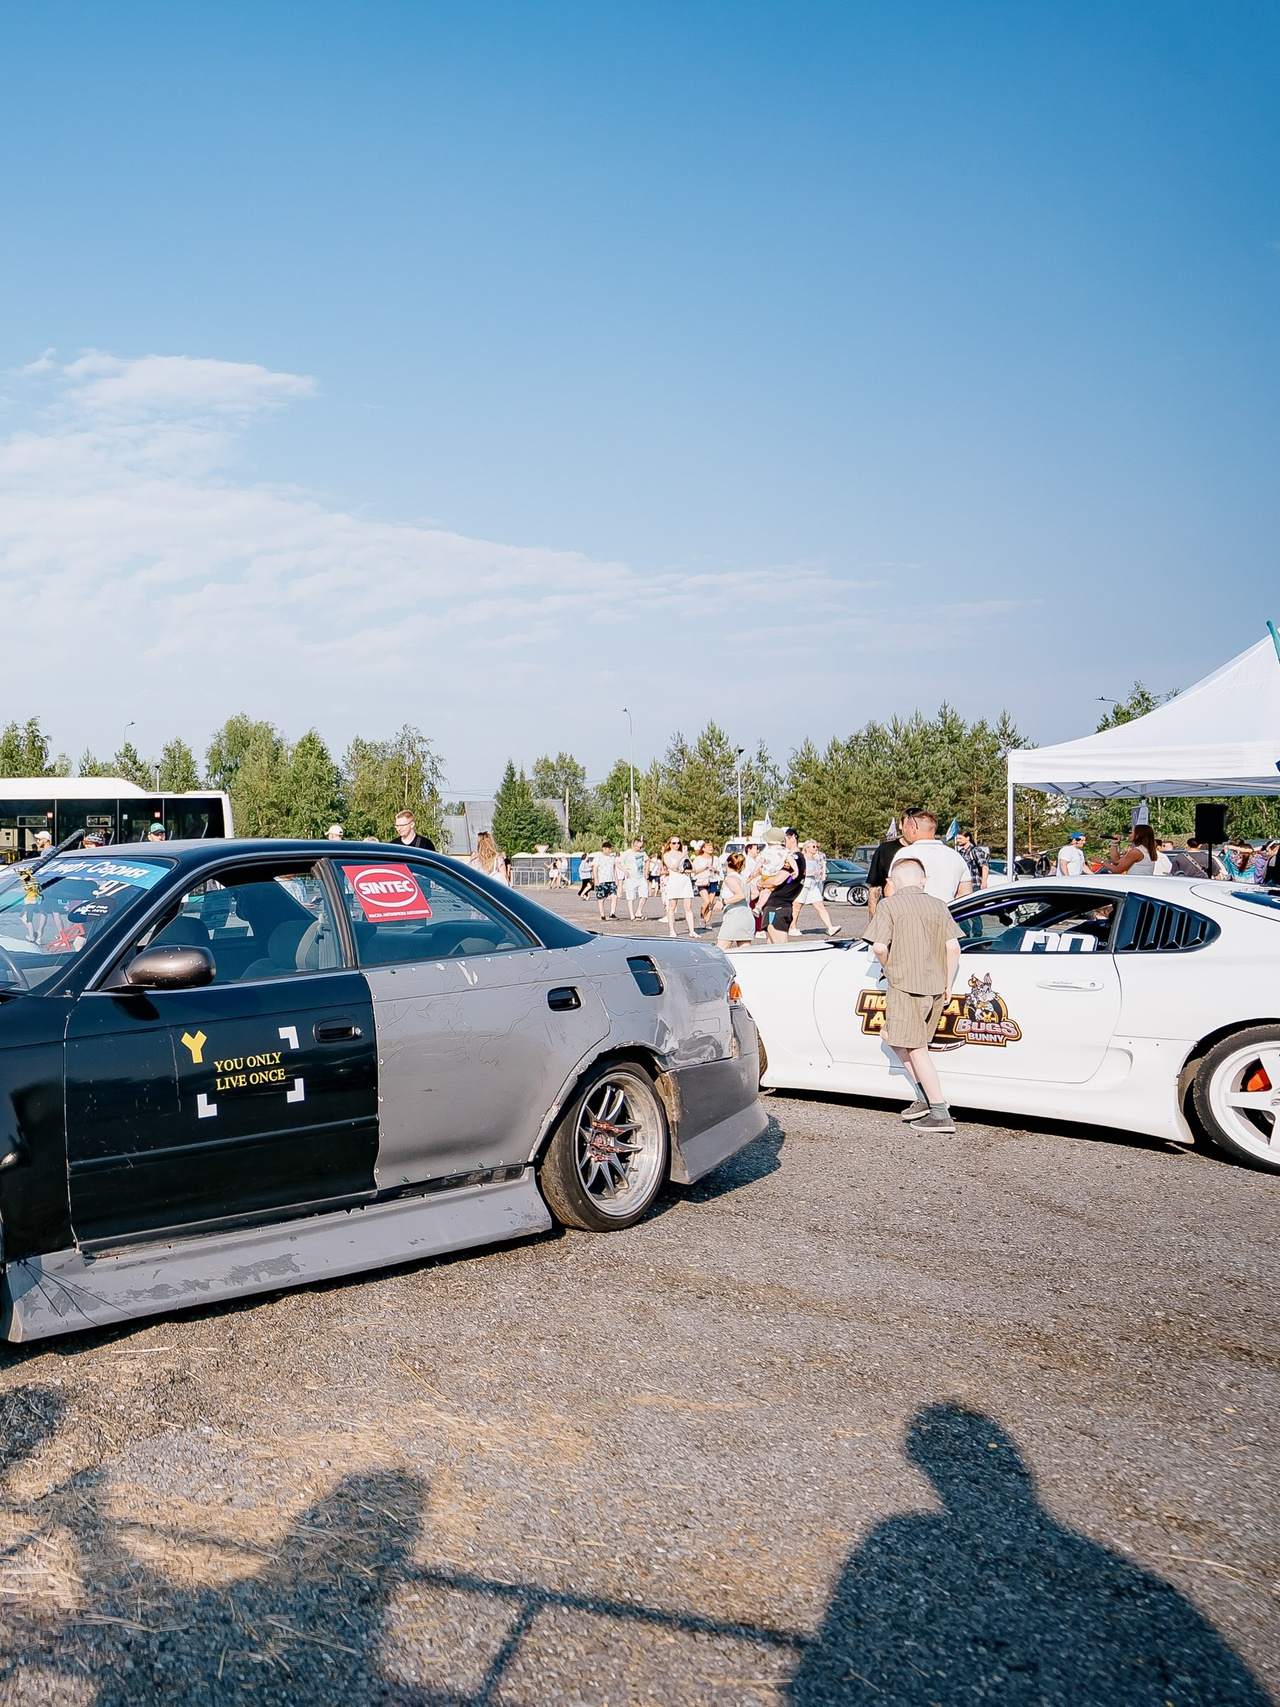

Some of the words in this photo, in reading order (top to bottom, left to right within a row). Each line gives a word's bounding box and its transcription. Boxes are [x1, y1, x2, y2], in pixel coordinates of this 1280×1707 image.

[358, 880, 414, 895] SINTEC
[956, 1019, 1018, 1037] BUGS
[968, 1032, 1005, 1042] BUNNY
[214, 1057, 244, 1073] YOU
[246, 1052, 282, 1070] ONLY
[216, 1075, 248, 1091] LIVE
[249, 1068, 287, 1085] ONCE
